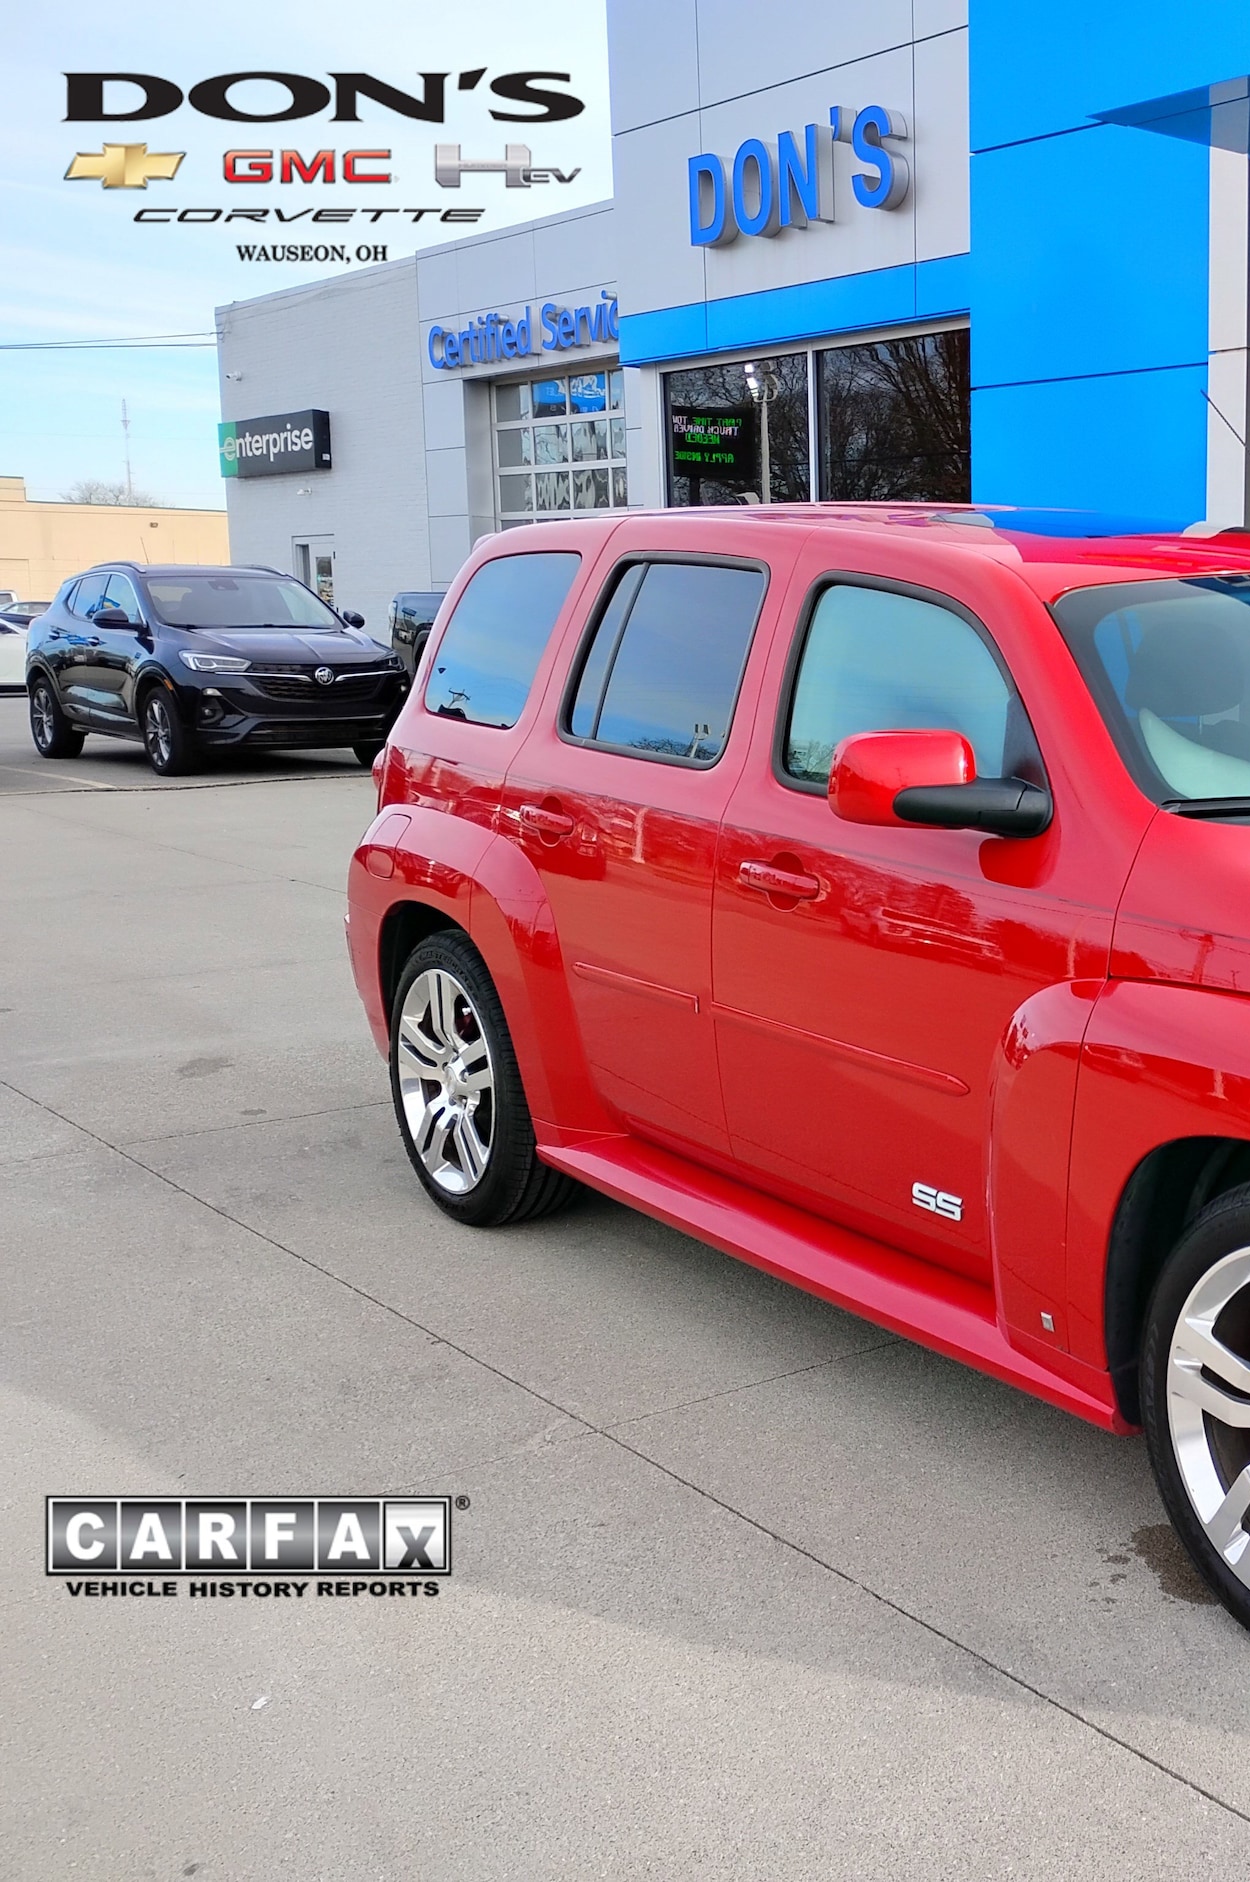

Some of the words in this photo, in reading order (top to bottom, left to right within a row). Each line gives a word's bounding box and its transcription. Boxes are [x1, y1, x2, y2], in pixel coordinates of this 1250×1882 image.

[688, 104, 902, 248] DON'S
[428, 306, 534, 370] Certified
[219, 423, 314, 462] enterprise
[911, 1181, 964, 1222] SS
